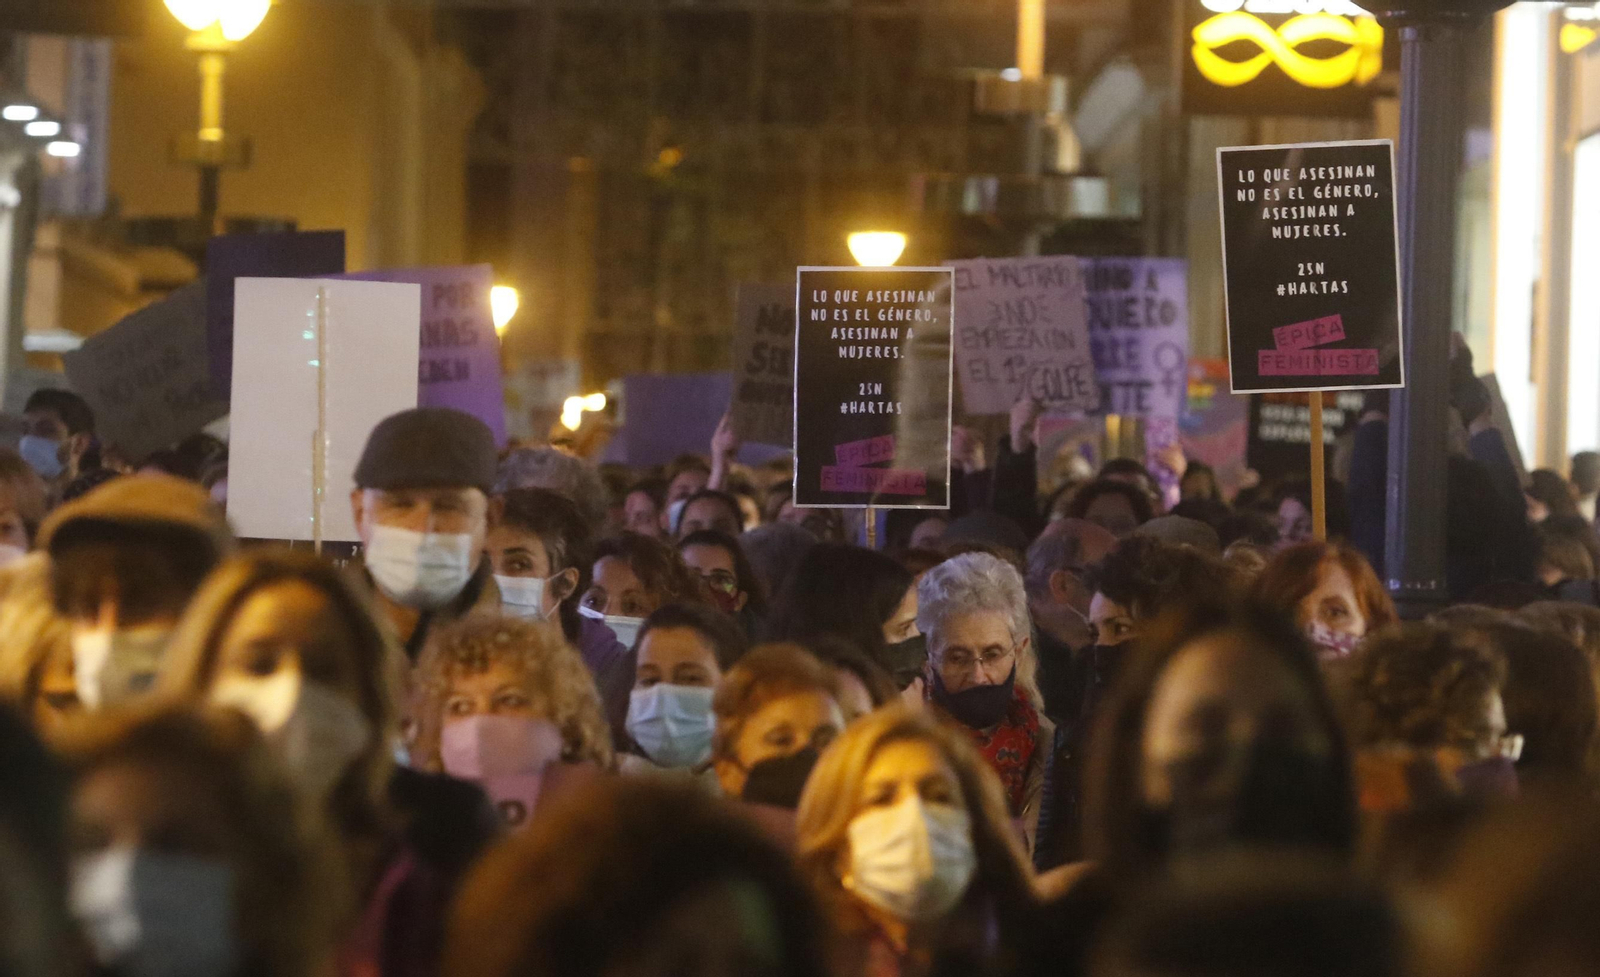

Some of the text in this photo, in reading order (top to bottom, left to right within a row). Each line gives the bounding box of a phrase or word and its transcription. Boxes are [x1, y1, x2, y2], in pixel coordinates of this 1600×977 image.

[1238, 165, 1376, 184] LO QUE ASESINAN
[1237, 183, 1379, 202] NO ES EL GÉNERO,
[1262, 203, 1356, 220] ASESINAN A
[1272, 224, 1348, 239] MUJERES.
[1297, 262, 1325, 276] 25N
[1276, 280, 1349, 297] #HARTAS
[813, 289, 936, 305] LO QUE ASESINAN
[810, 306, 938, 324] NO ES EL GÉNERO,
[831, 327, 915, 340] ASESINAN A
[838, 345, 905, 359] MUJERES.
[1259, 353, 1378, 370] FEMINISTA
[858, 382, 883, 396] 25N
[840, 401, 903, 415] #HARTAS
